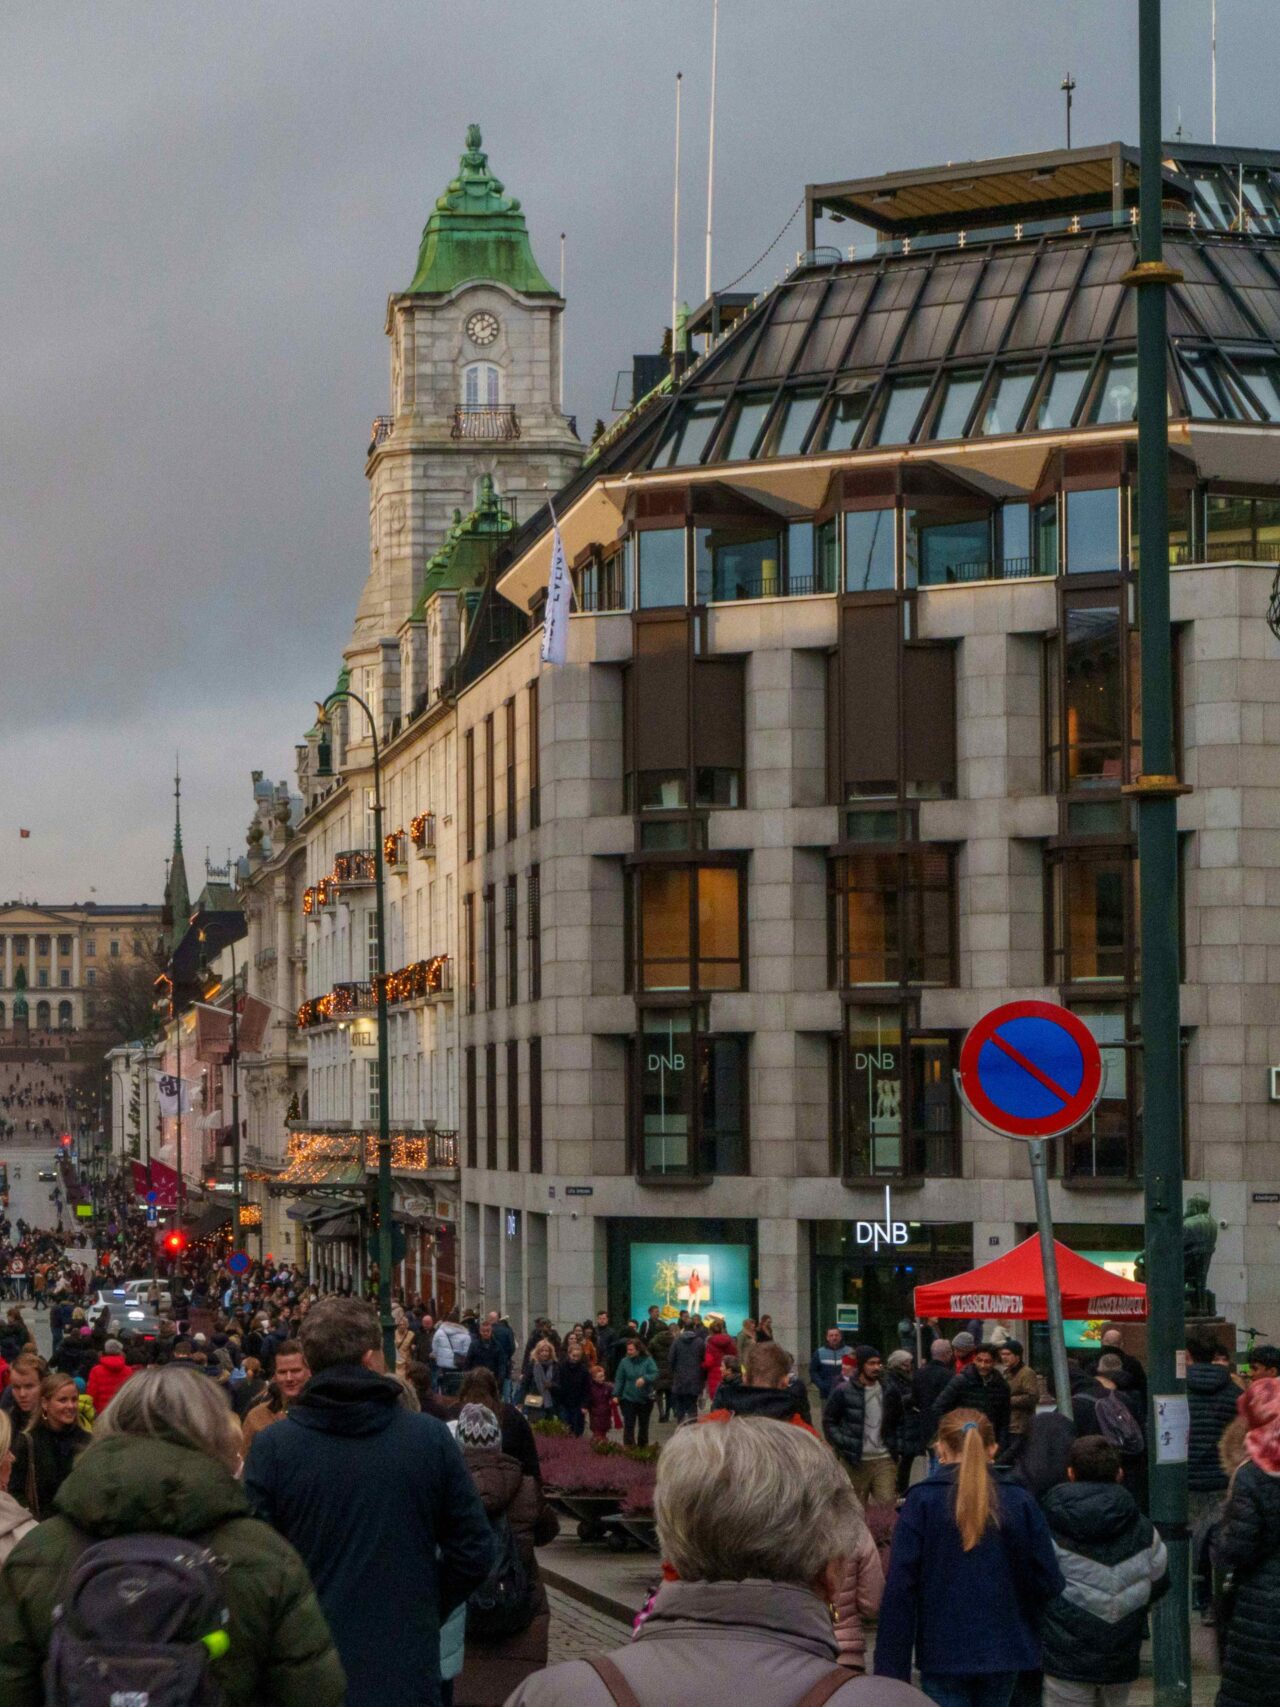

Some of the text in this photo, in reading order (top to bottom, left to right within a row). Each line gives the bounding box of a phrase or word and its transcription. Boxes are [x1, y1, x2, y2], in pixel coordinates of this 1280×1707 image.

[352, 1032, 376, 1047] OTEL
[648, 1054, 685, 1071] DNB
[855, 1053, 895, 1070] DNB
[950, 1295, 1023, 1313] KLASSEKAMPEN
